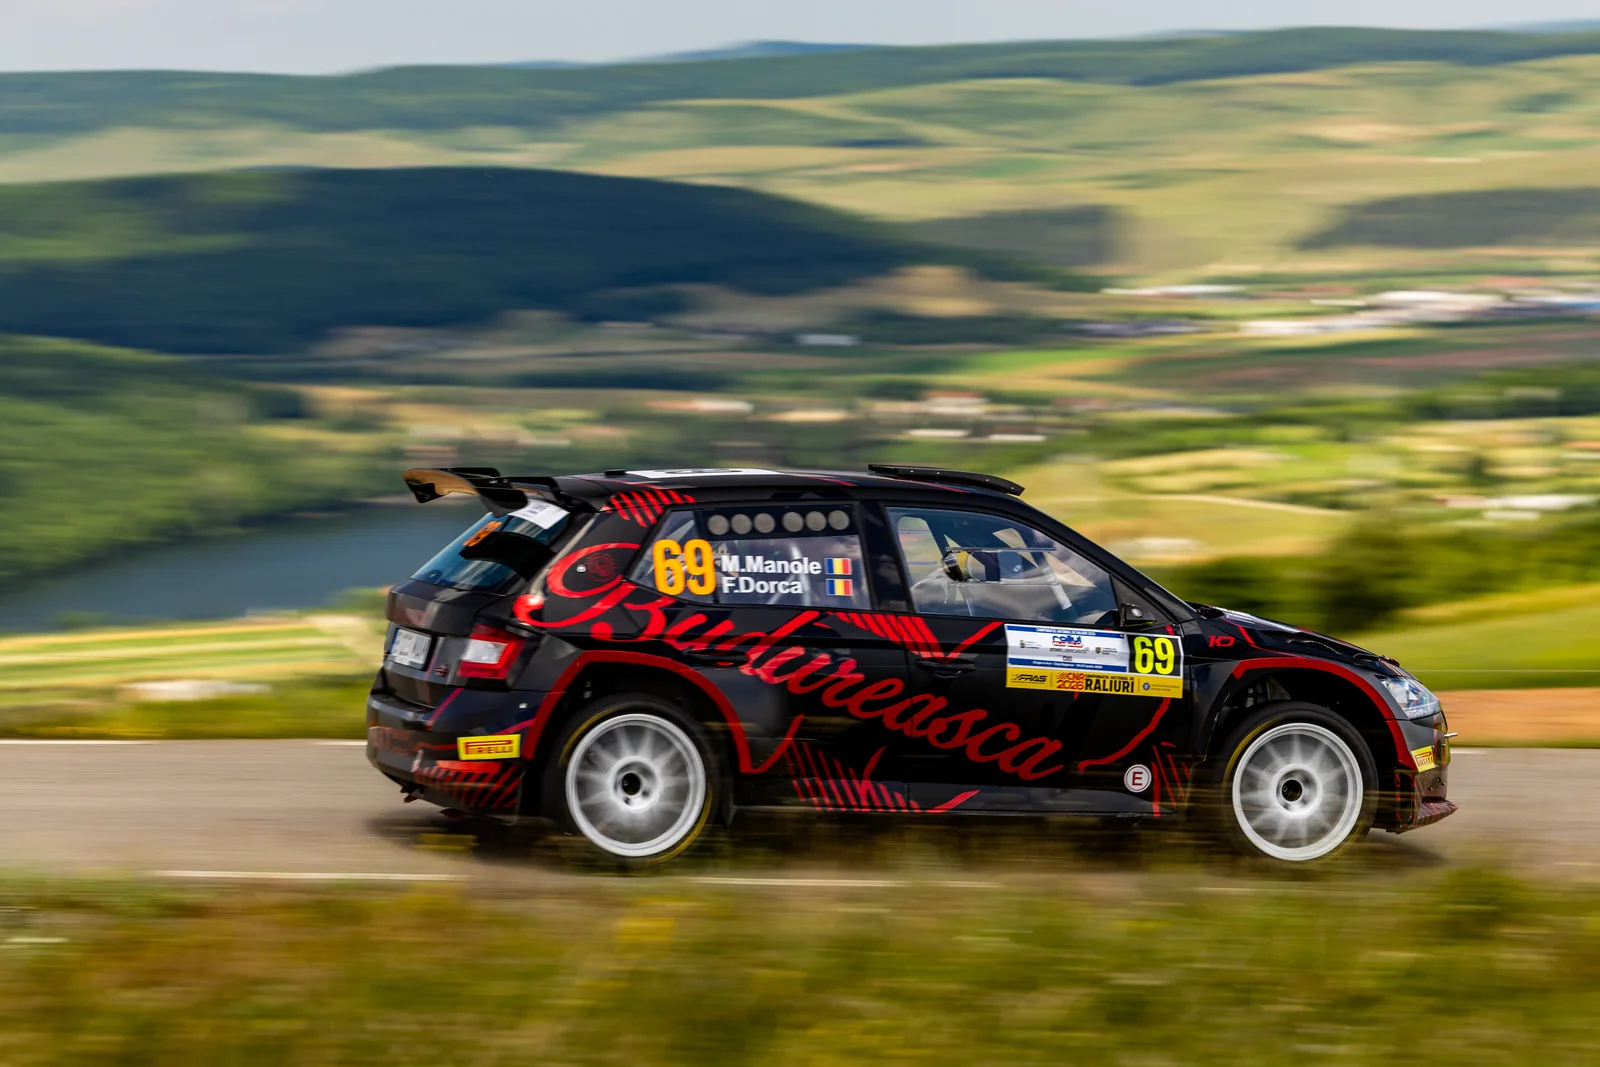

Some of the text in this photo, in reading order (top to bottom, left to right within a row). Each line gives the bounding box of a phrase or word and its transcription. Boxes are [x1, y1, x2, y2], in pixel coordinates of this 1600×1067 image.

[653, 539, 717, 596] 69
[721, 554, 822, 575] M.Manole
[722, 576, 804, 594] F.Dorca
[513, 541, 1064, 781] Budureasca
[1134, 635, 1175, 675] 69
[1018, 674, 1048, 683] FRAS
[1056, 679, 1085, 691] 2026
[1085, 678, 1135, 693] RALIURI
[464, 739, 513, 755] PIRELLI
[1131, 771, 1144, 786] E
